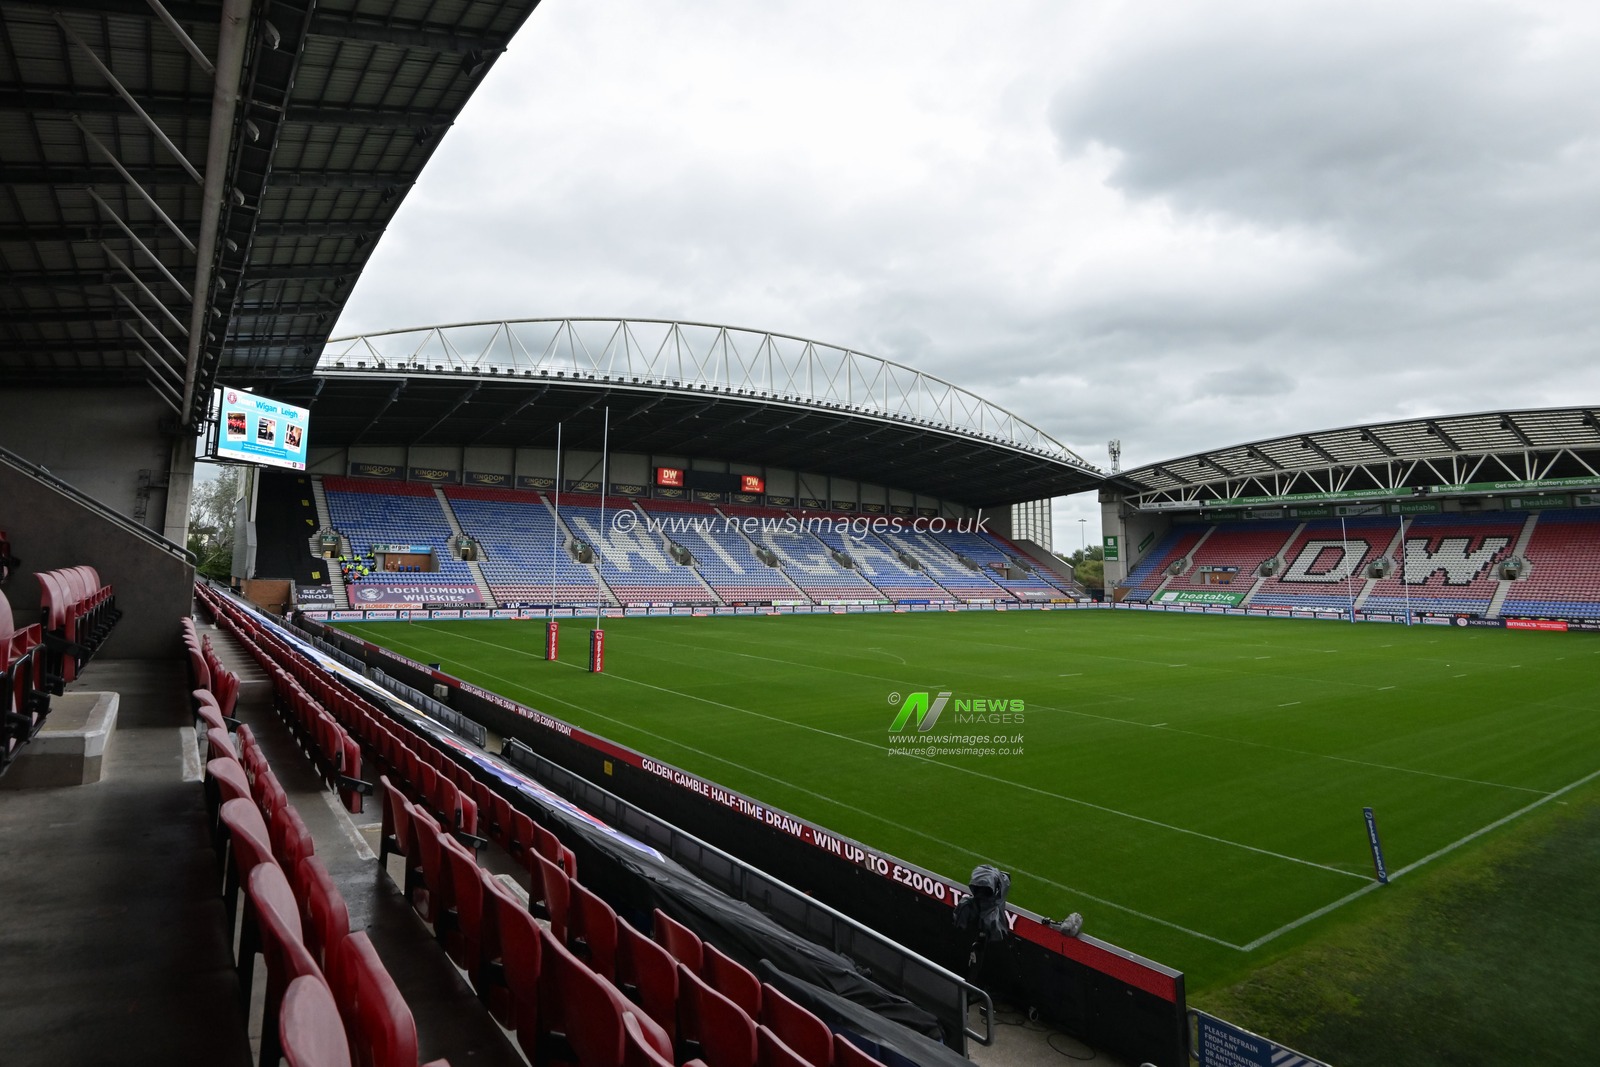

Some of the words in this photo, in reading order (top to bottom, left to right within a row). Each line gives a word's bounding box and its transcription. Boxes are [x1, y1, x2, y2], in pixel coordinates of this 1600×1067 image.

[256, 401, 278, 413] Wigan
[281, 408, 298, 419] Leigh
[415, 469, 449, 478] KINGDOM
[663, 469, 678, 480] DW
[746, 477, 759, 486] DW
[1180, 592, 1235, 601] heatable
[460, 682, 472, 694] GOLDEN
[472, 687, 485, 698] GAMBLE
[485, 692, 503, 707] HALF-TIME
[503, 700, 516, 712] DRAW
[518, 707, 527, 717] WIN
[528, 710, 534, 720] UP
[534, 713, 540, 723] TO
[540, 716, 555, 729] £2000
[555, 722, 572, 736] TODAY
[642, 758, 672, 780] GOLDEN
[674, 772, 709, 796] GAMBLE
[712, 786, 763, 821] HALF-TIME
[766, 811, 803, 837] DRAW
[813, 830, 841, 856] WIN
[845, 843, 864, 864] UP
[867, 854, 889, 876] TO
[893, 865, 945, 901] £2000
[1204, 1024, 1228, 1040] PLEASE
[1229, 1035, 1258, 1053] REFRAIN
[1204, 1033, 1224, 1046] FROM
[1224, 1041, 1238, 1052] ANY
[1205, 1048, 1214, 1058] OR
